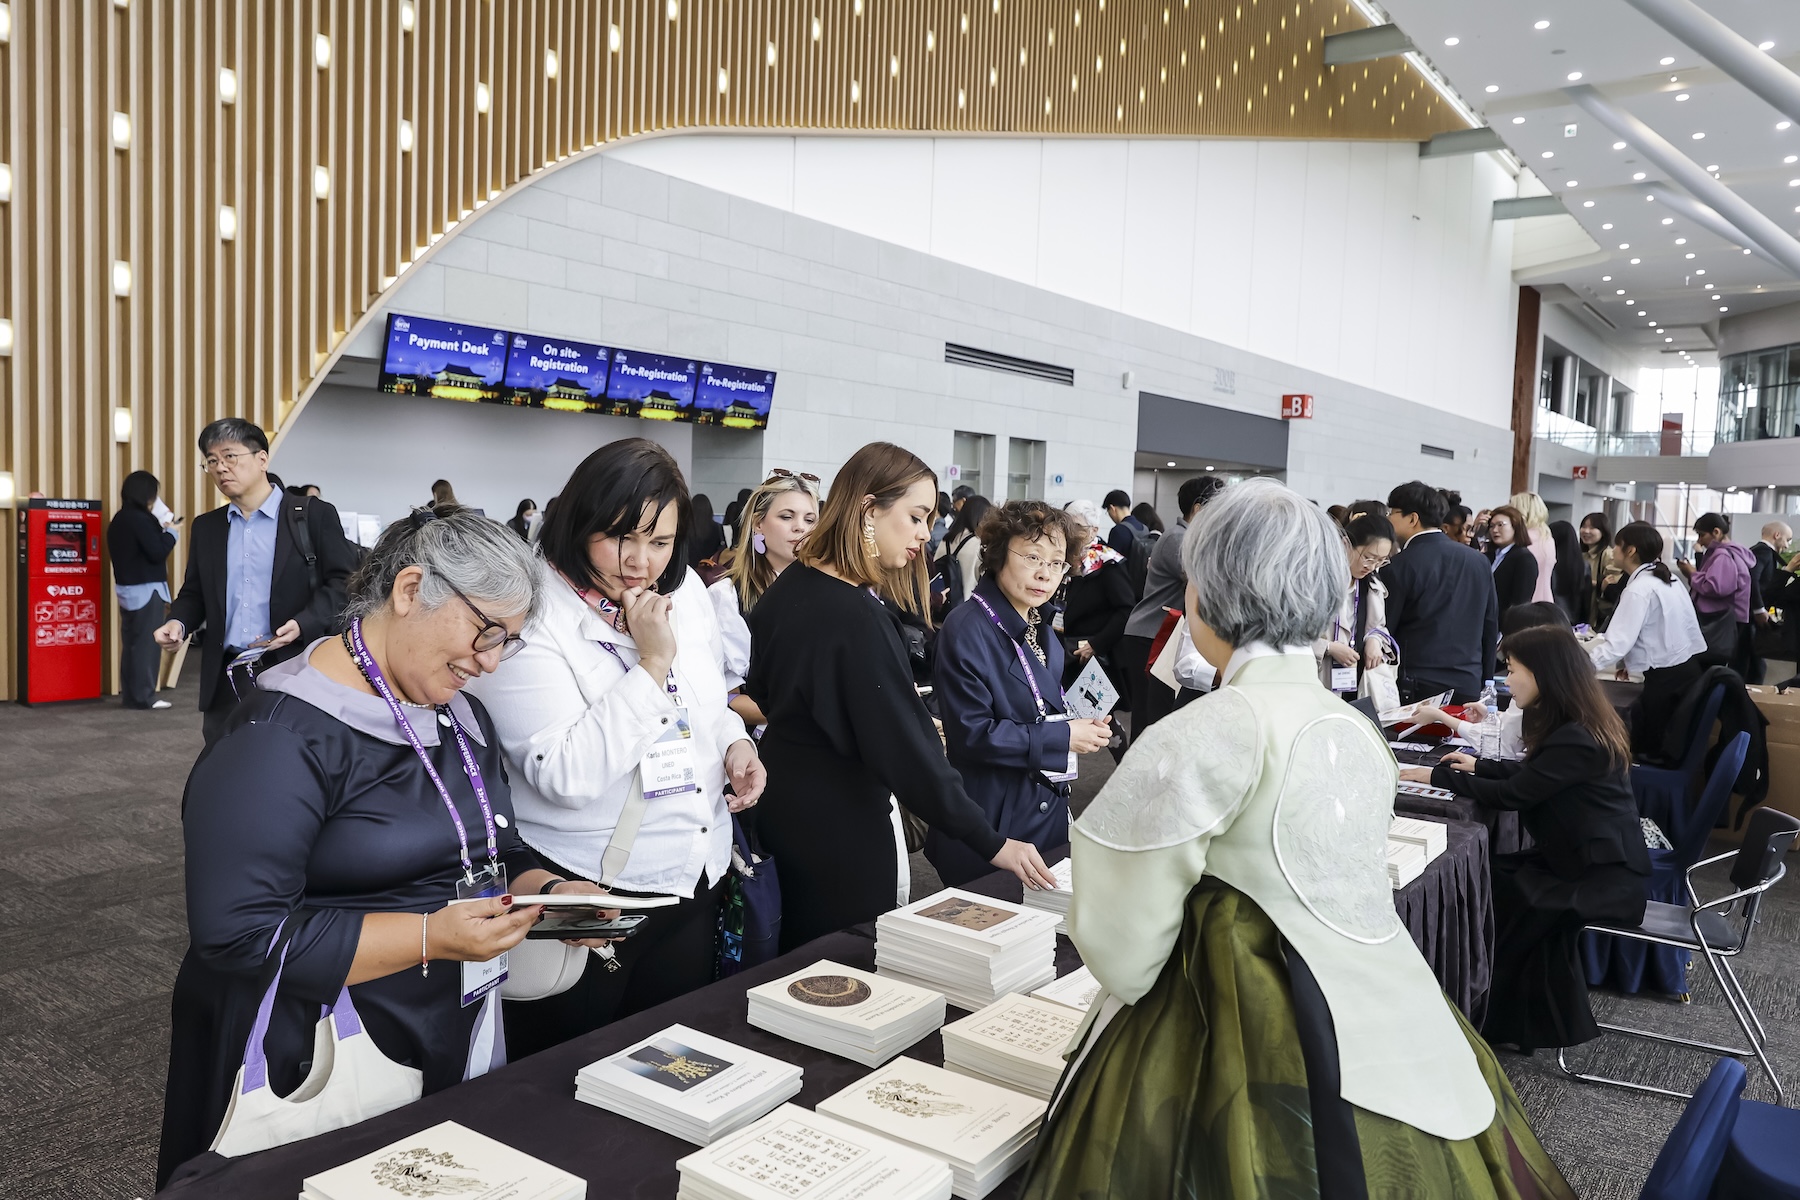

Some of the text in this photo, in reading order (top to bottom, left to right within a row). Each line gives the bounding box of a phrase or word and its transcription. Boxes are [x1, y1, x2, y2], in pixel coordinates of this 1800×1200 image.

[409, 334, 490, 356] Payment Desk
[542, 344, 581, 359] On site-
[530, 356, 588, 374] Registration
[621, 364, 688, 383] Pre-Registration
[707, 376, 766, 392] Pre-Registration
[1292, 396, 1302, 416] B
[1578, 467, 1585, 478] C
[60, 586, 84, 596] AED
[355, 638, 364, 652] WIN
[360, 651, 372, 667] 33rd
[374, 676, 454, 810] 33rd WIN GLOBAL ANNUAL CONFERENCE
[445, 707, 478, 777] ANNUAL CONFERENCE
[646, 747, 688, 759] Karla MONTERO
[477, 788, 486, 803] 33rd
[654, 786, 686, 797] PARTICIPANT
[482, 967, 492, 976] Peru
[472, 978, 500, 998] PARTICIPANT
[730, 1078, 755, 1092] Wonders
[706, 1095, 725, 1104] Korea
